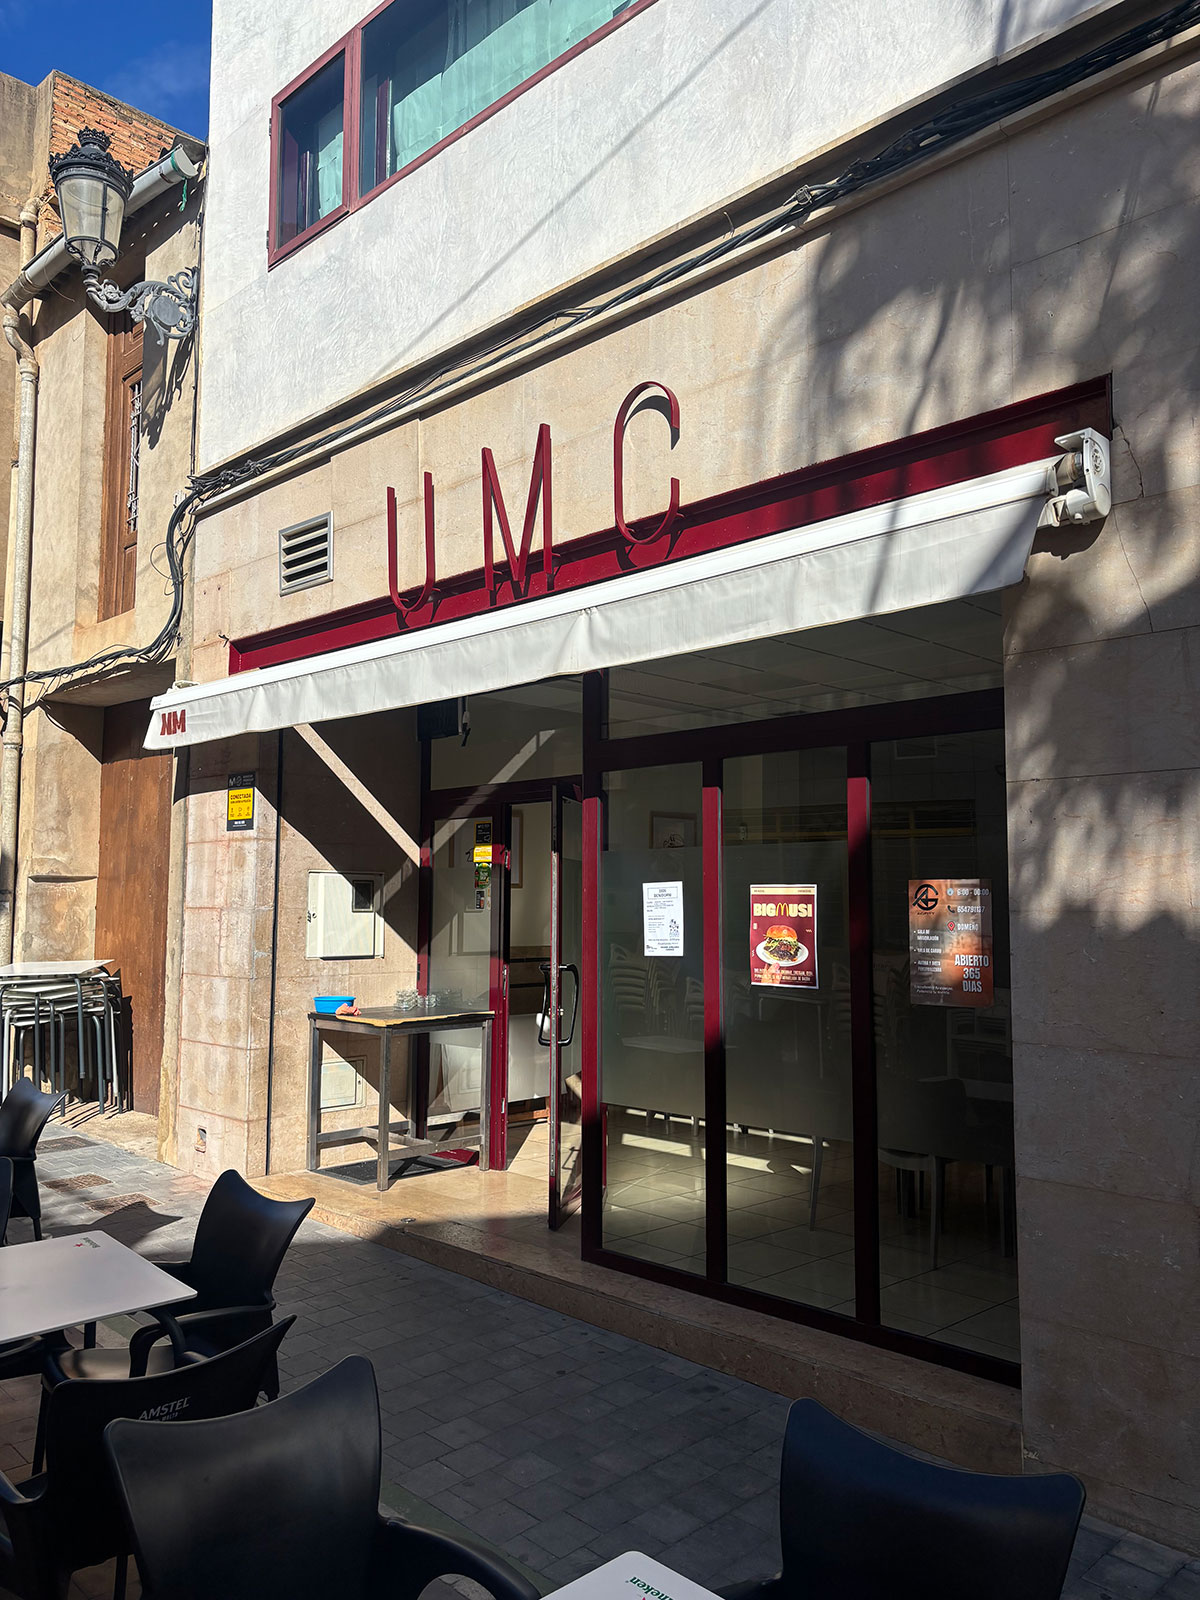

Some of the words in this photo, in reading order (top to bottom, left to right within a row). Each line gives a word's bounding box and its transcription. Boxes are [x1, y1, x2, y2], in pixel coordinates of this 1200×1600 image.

[955, 954, 989, 967] ABIERTO
[963, 967, 980, 980] 365
[138, 1396, 191, 1421] AMSTEL
